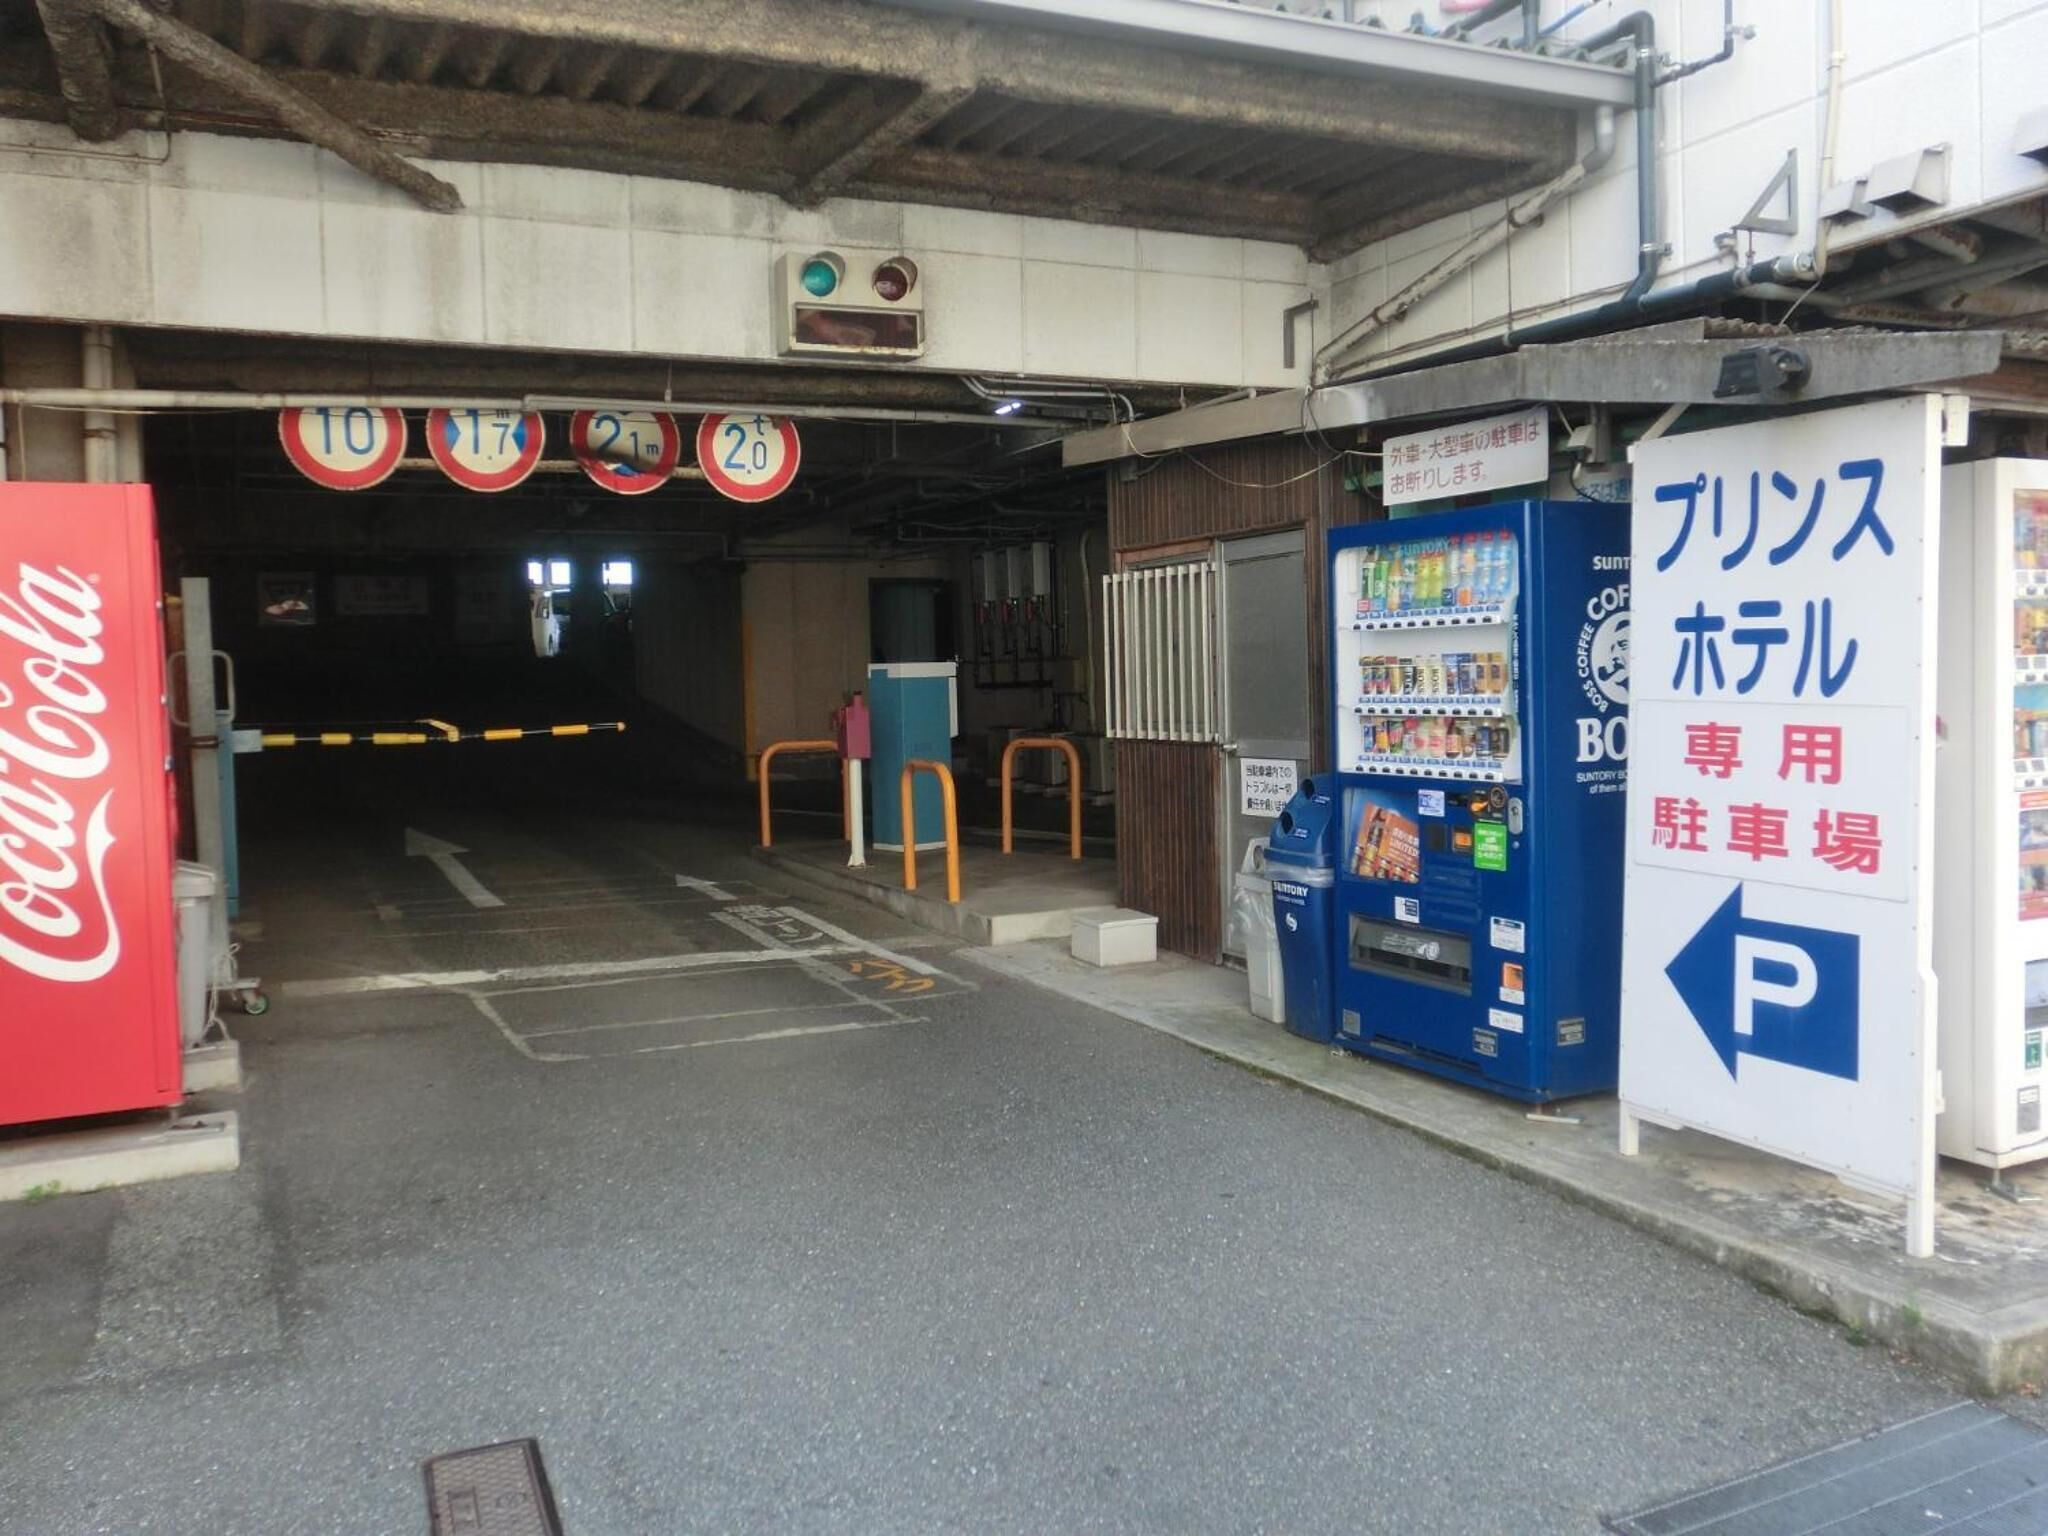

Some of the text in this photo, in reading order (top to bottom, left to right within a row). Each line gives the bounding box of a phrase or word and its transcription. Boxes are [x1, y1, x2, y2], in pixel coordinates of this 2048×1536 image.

[316, 407, 375, 455] 10
[1390, 417, 1540, 467] 外車・大型車の駐車は
[1655, 458, 1895, 573] プリンス
[1576, 622, 1595, 678] COFFEE
[1672, 596, 1859, 699] ホテル
[1576, 770, 1616, 783] SUNTORY
[1684, 721, 1843, 786] 専用
[1652, 796, 1882, 875] 駐車場
[1733, 934, 1818, 1036] P
